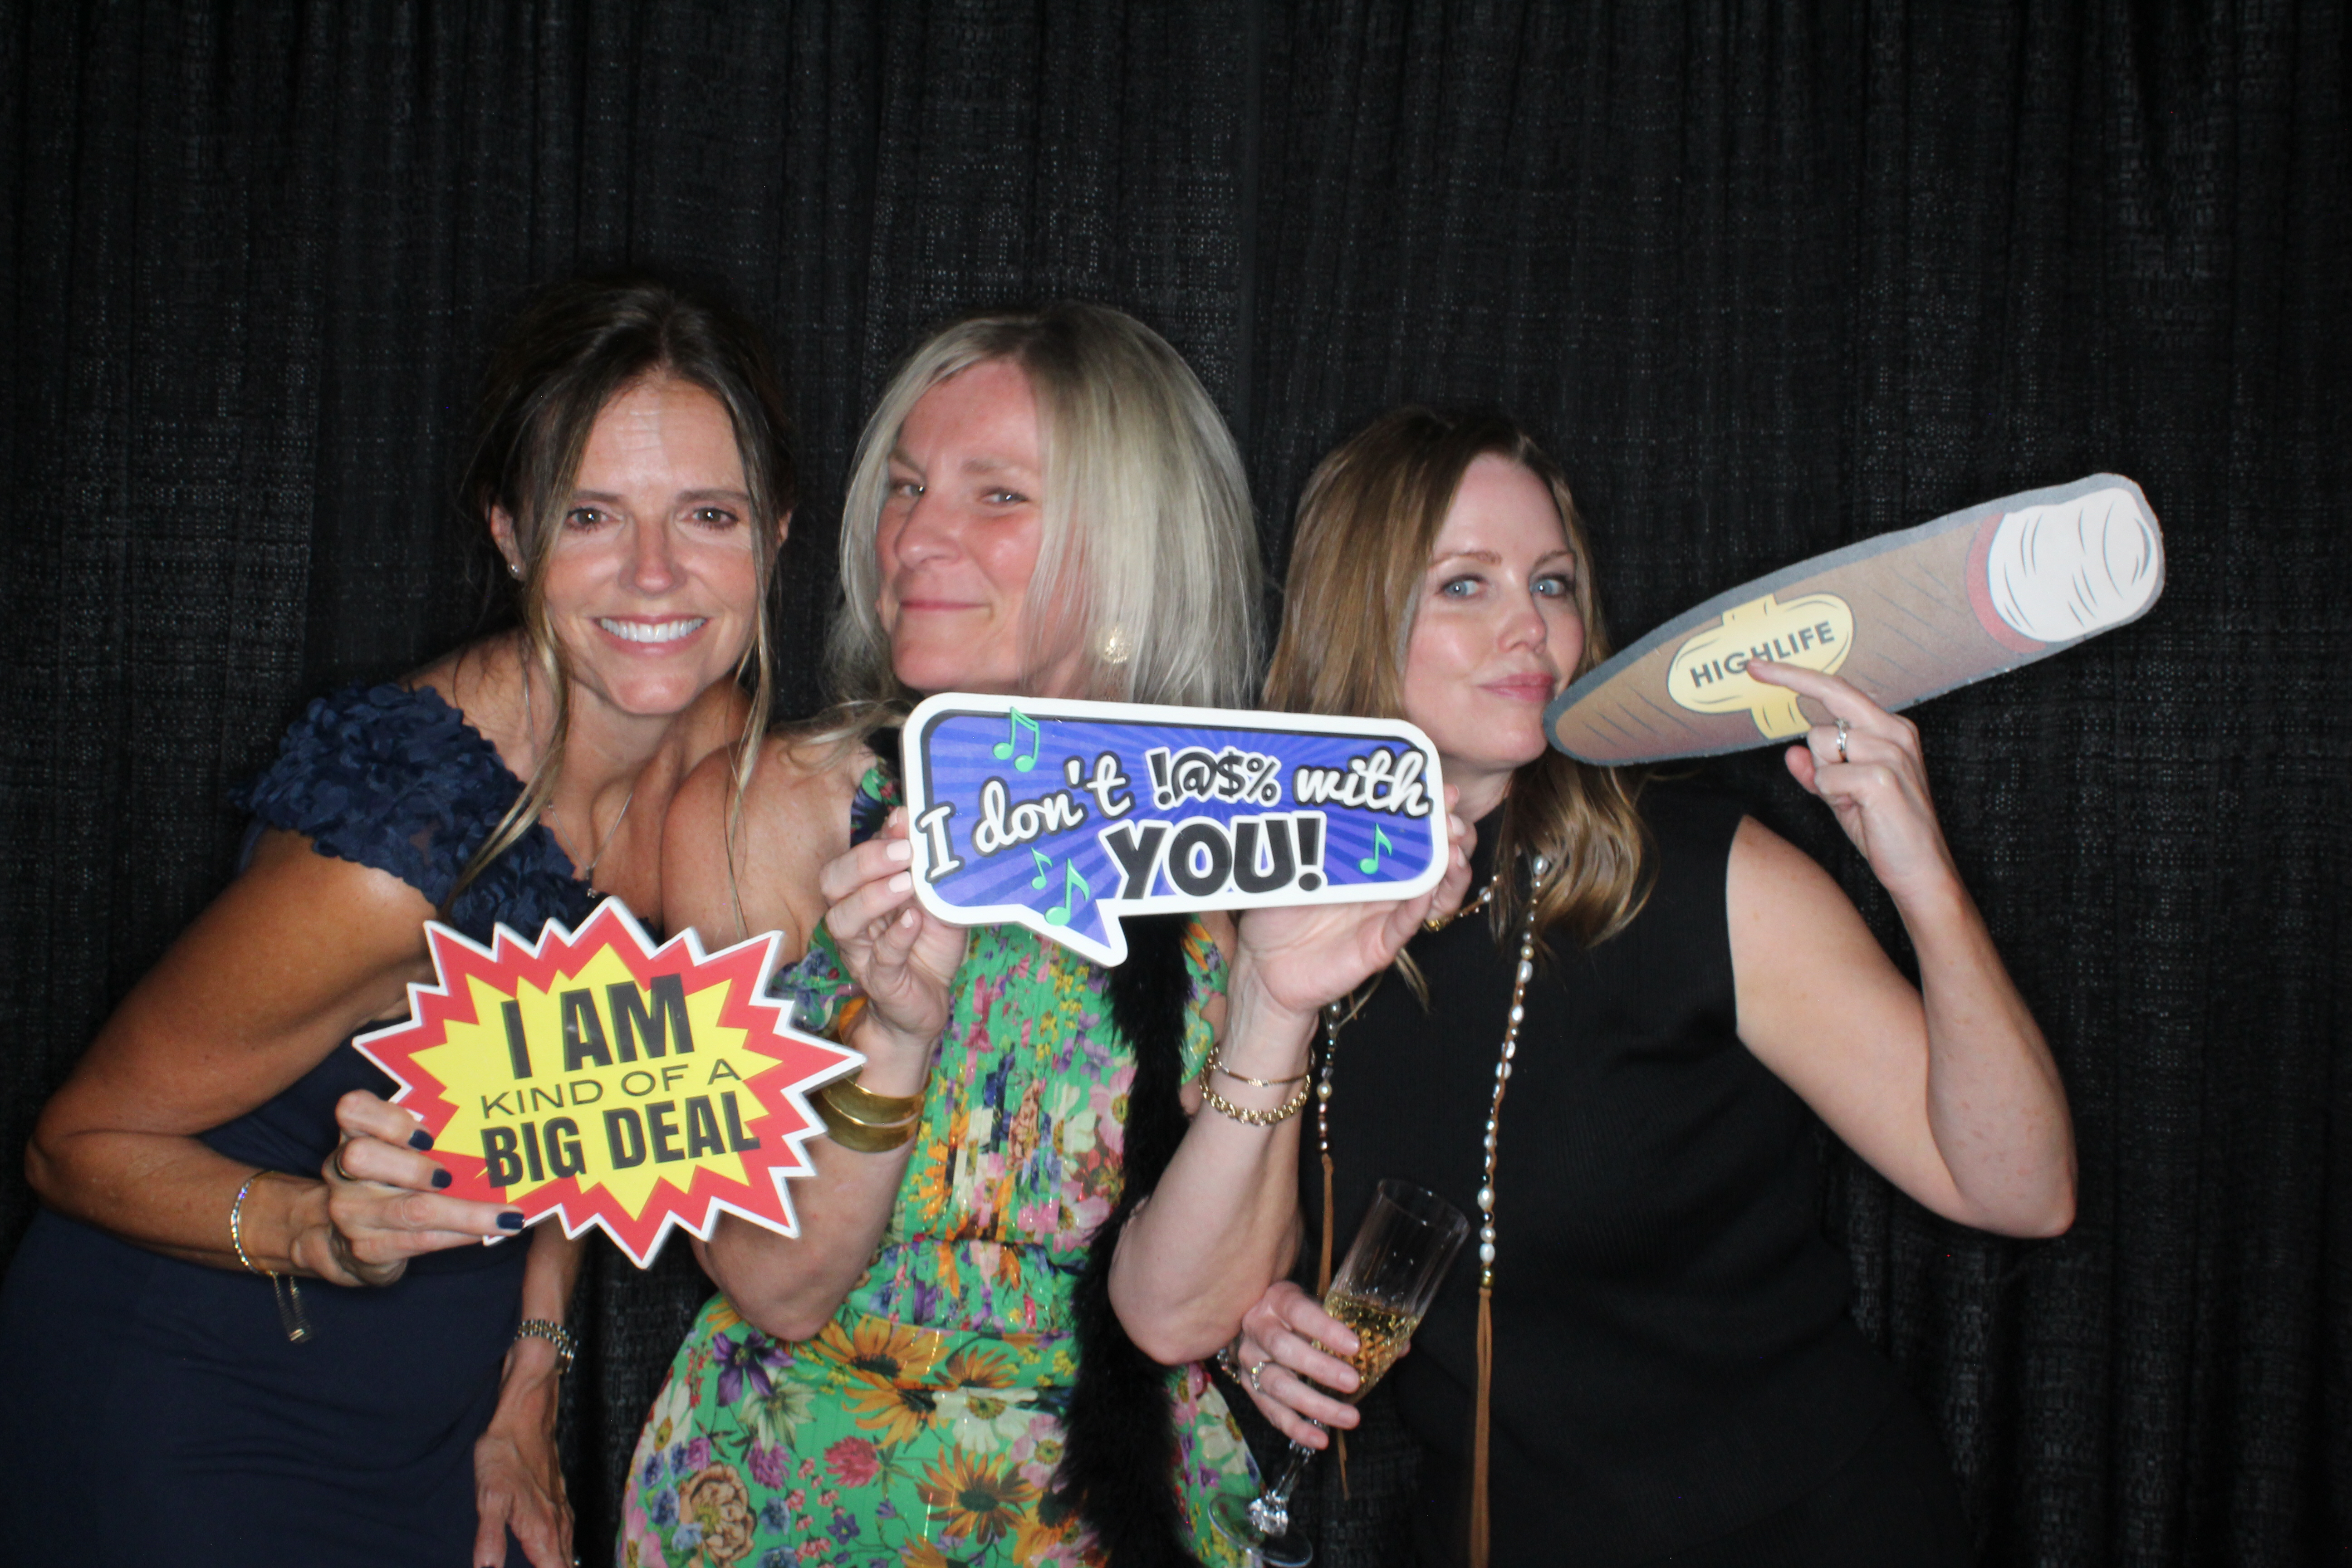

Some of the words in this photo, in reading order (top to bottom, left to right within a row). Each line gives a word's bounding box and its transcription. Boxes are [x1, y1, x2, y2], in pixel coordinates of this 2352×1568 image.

[1690, 621, 1835, 688] HIGHLIFE
[917, 804, 962, 883] I
[972, 753, 1133, 855] don't
[1148, 749, 1281, 806] !@$%
[1296, 750, 1431, 815] with
[1104, 817, 1325, 899] YOU!
[500, 999, 533, 1079] I
[560, 973, 695, 1071] AM
[480, 1079, 603, 1119] KIND
[621, 1064, 689, 1097] OF
[707, 1058, 741, 1085] A
[480, 1116, 587, 1188] BIG
[603, 1091, 760, 1170] DEAL
